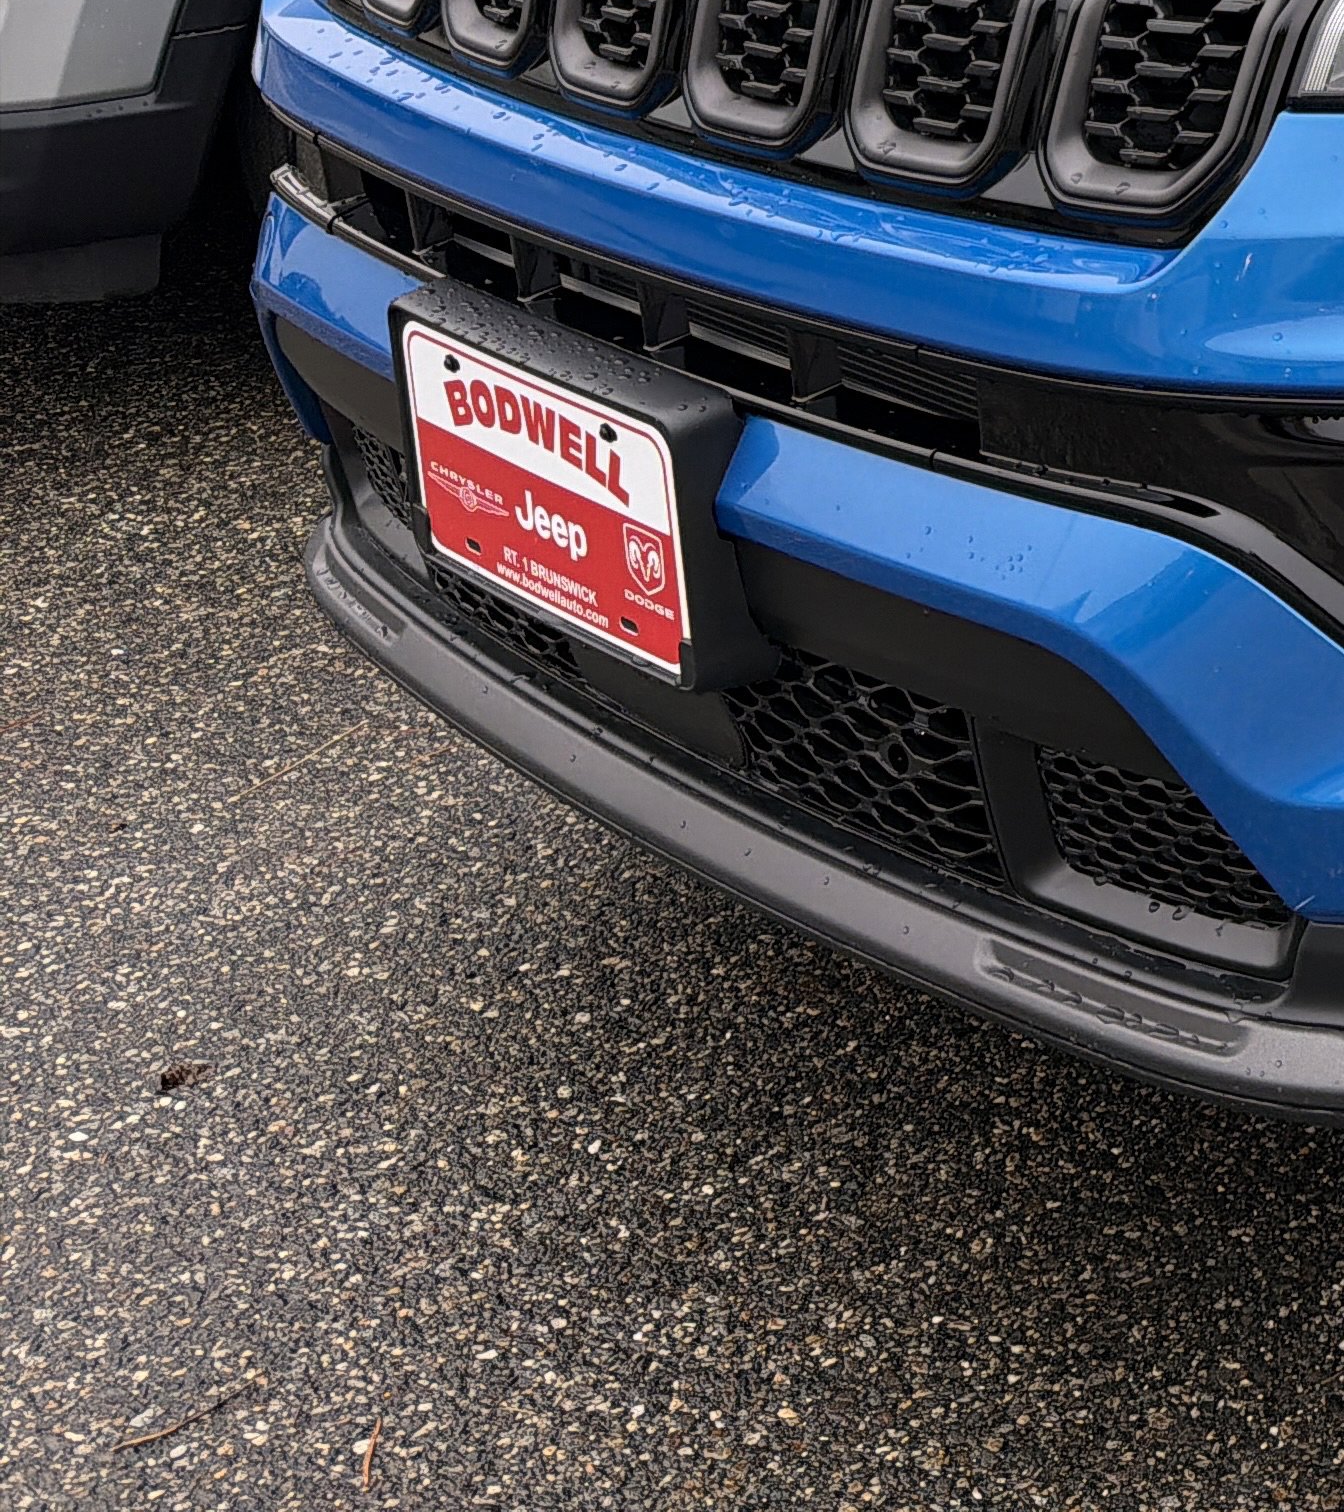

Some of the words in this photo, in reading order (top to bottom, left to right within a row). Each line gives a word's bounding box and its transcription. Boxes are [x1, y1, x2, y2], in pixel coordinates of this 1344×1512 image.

[444, 379, 630, 507] BODWELL
[430, 461, 504, 505] CHRYSLER
[515, 489, 588, 561] Jeep
[496, 561, 609, 629] www.bodwellauto.com
[503, 545, 520, 568] RT.
[522, 556, 529, 572] 1
[530, 559, 598, 608] BRUNSWICK
[624, 590, 675, 621] DODGE
